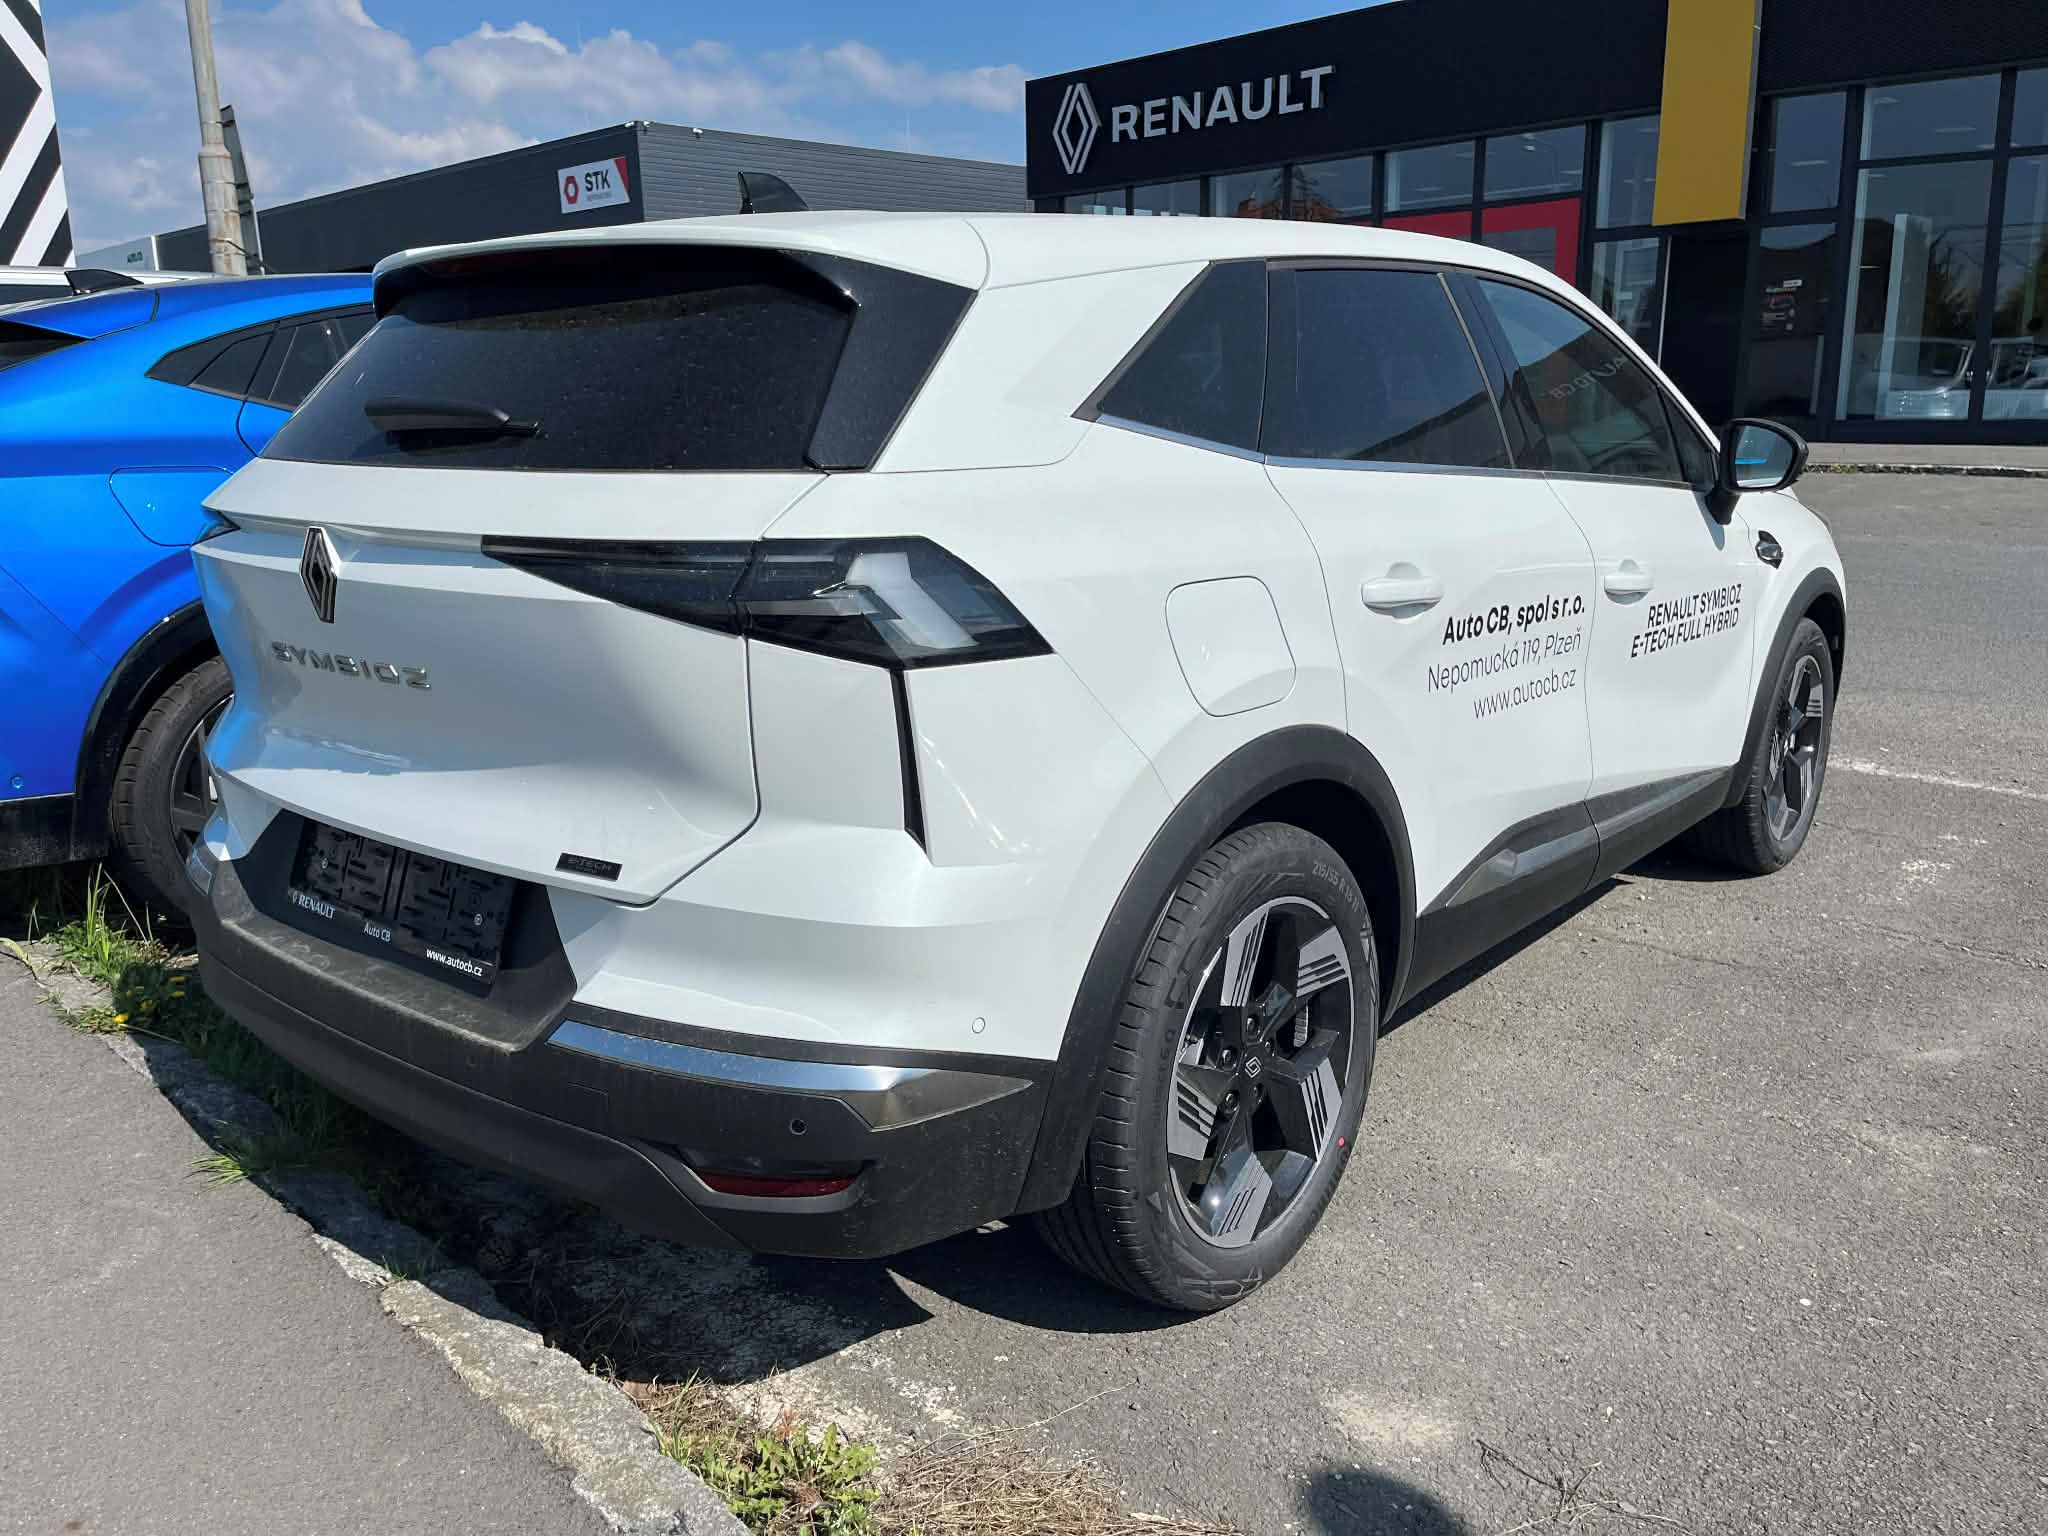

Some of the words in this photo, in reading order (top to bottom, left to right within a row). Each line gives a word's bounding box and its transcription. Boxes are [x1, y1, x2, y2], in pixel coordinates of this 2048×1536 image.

[1111, 65, 1335, 142] RENAULT
[585, 169, 611, 192] STK
[1442, 616, 1484, 646] Auto
[1486, 605, 1513, 635] CB,
[1517, 594, 1550, 632] spol
[1647, 594, 1699, 628] RENAULT
[1700, 583, 1742, 613] SYMBIOZ
[1631, 623, 1676, 658] E-TECH
[1676, 618, 1701, 644] FULL
[1703, 607, 1739, 637] HYBRID
[272, 640, 432, 690] SYMBIOZ
[1427, 639, 1519, 693] Nepomucká
[1522, 637, 1541, 665] 119,
[1544, 626, 1582, 659] Plzeň
[1473, 668, 1577, 720] www.autocb.cz
[298, 894, 336, 919] RENAULT
[363, 921, 380, 938] Auto
[381, 928, 391, 942] CB
[426, 948, 483, 977] www.autocb.cz
